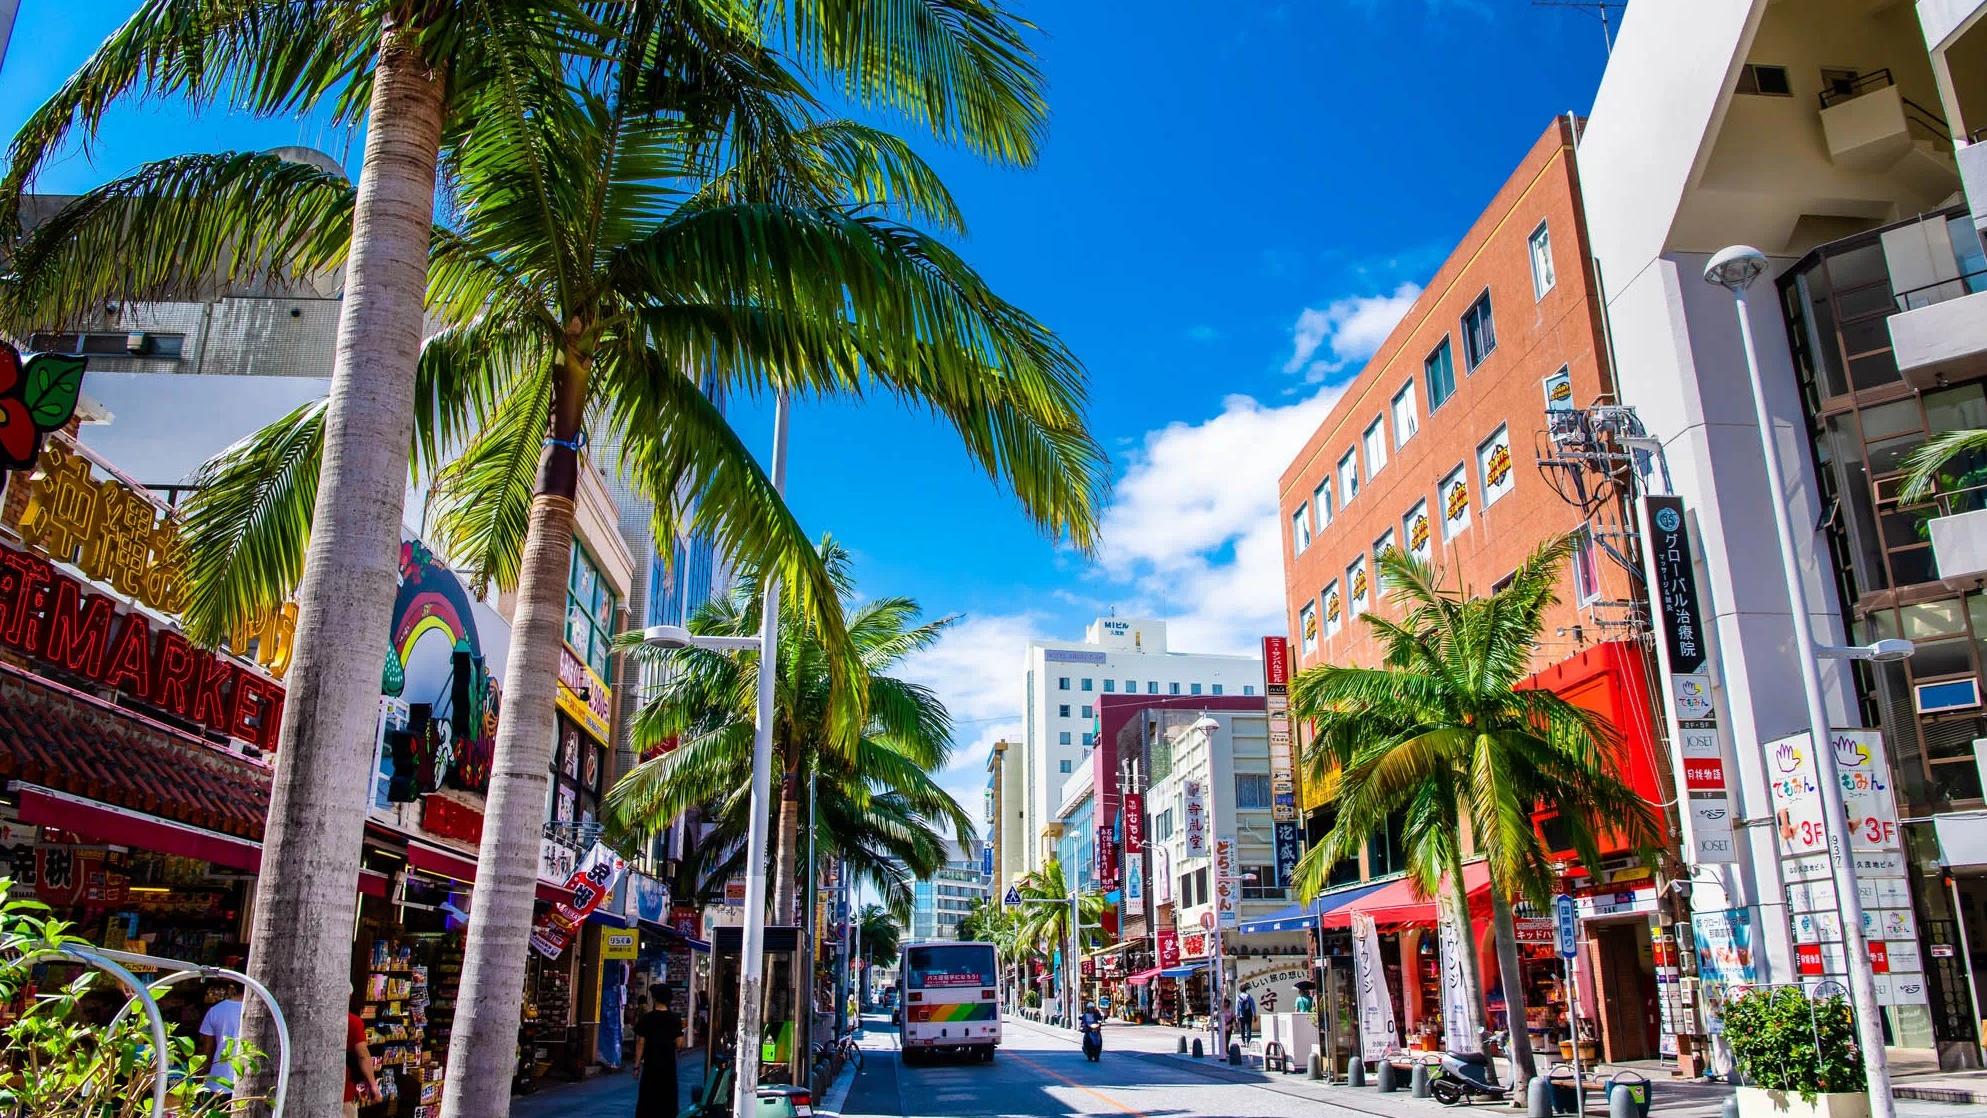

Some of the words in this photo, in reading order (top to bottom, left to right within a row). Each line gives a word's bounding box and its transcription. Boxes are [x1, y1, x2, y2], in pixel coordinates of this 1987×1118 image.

[1489, 446, 1509, 471] DARTS
[1664, 534, 1697, 658] グローバル治療院
[1104, 621, 1129, 629] MIビル
[1679, 697, 1709, 708] てもみん
[1772, 776, 1816, 799] てもみん
[1841, 772, 1887, 791] もみん
[1801, 820, 1824, 846] 3F
[1864, 816, 1895, 844] 3F
[573, 862, 612, 910] 免税
[1516, 930, 1554, 939] キッドハ
[1359, 938, 1373, 993] ラウンジ
[1446, 922, 1459, 989] ラウンジ
[1260, 988, 1278, 1012] 守
